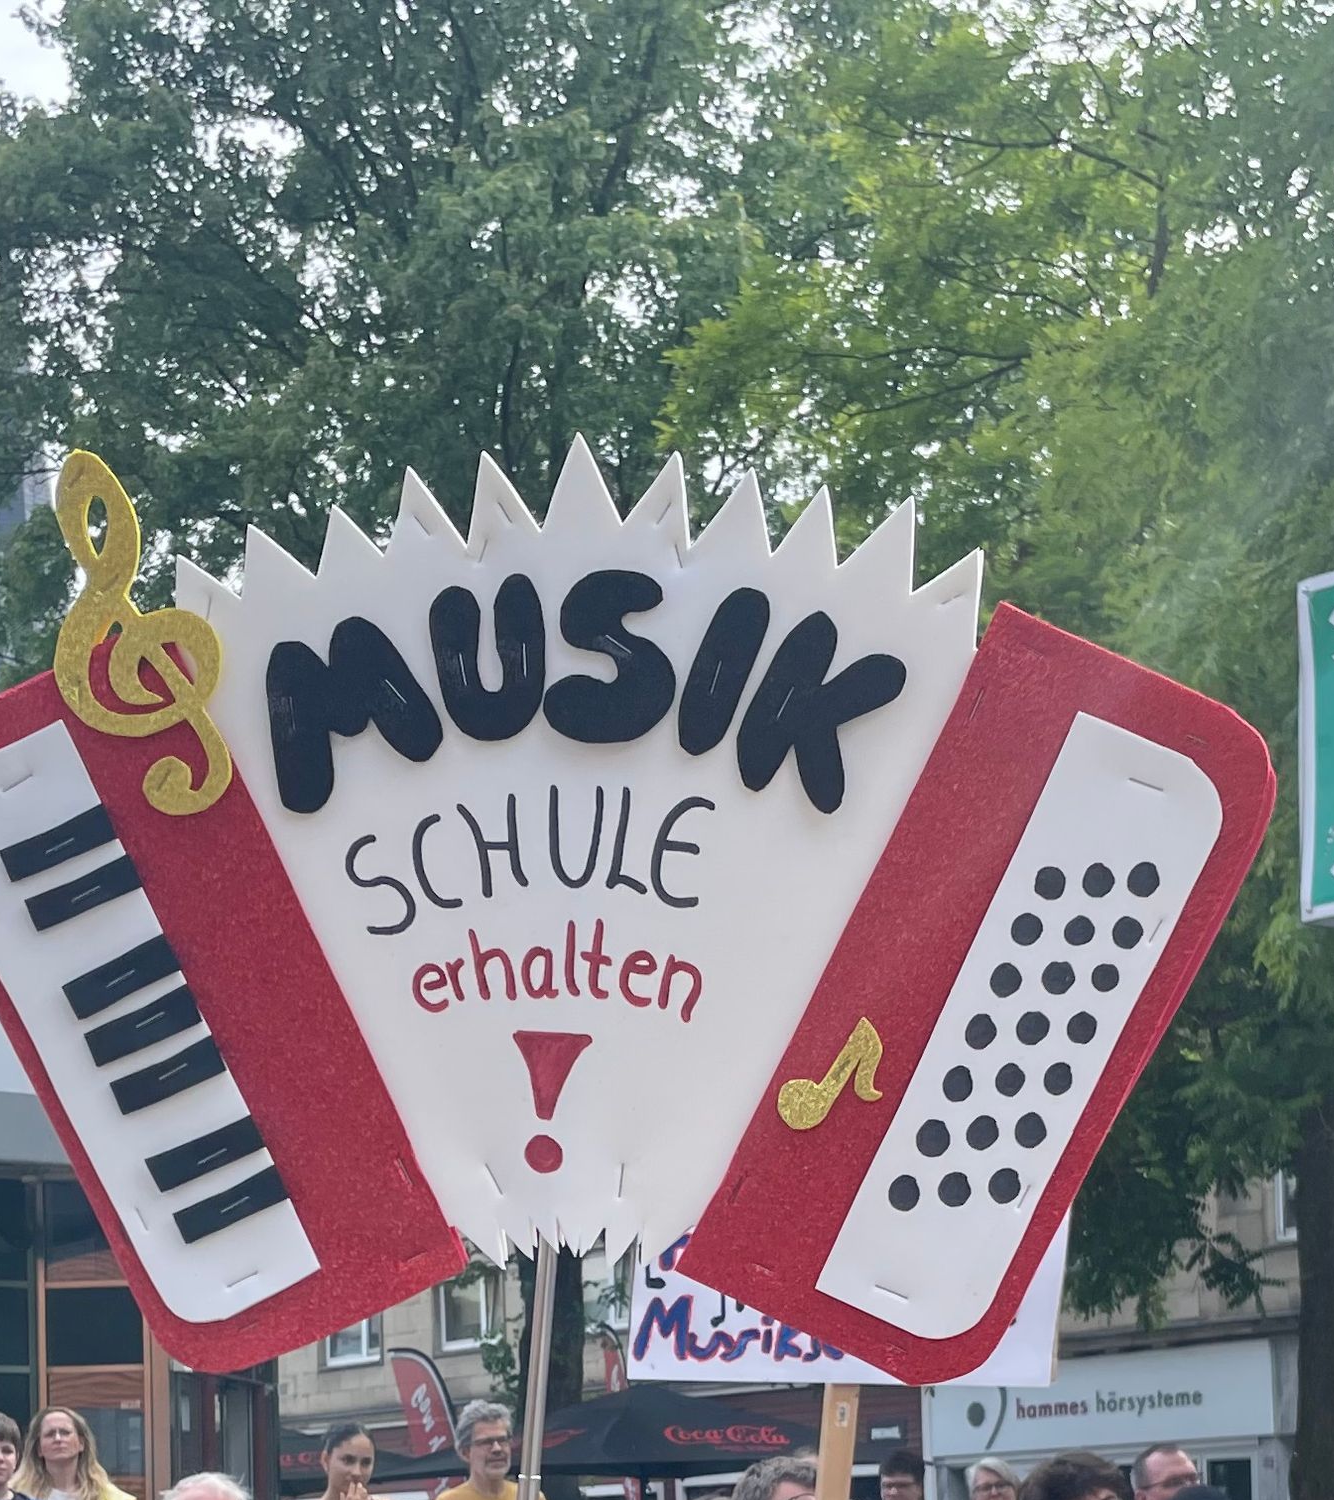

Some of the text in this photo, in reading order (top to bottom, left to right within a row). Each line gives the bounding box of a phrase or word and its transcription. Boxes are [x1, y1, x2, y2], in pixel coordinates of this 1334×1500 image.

[267, 570, 907, 814] MUSIK
[345, 785, 715, 935] SCHULE
[412, 918, 703, 1023] erhalten
[513, 1030, 592, 1173] !
[1016, 1389, 1203, 1419] hammes hörsysteme
